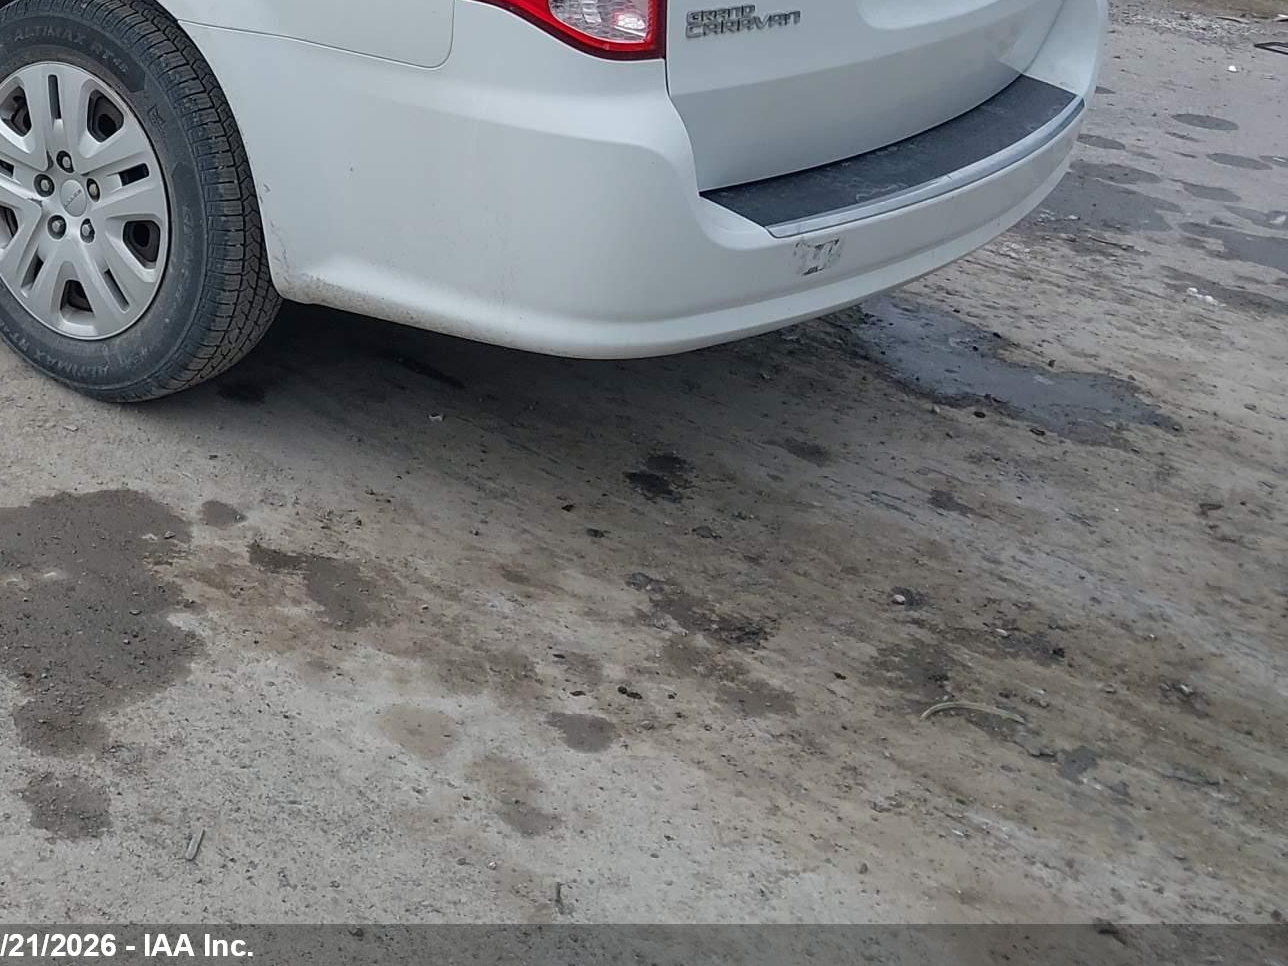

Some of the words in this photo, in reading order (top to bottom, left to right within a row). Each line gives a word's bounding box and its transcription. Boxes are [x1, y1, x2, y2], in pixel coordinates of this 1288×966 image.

[685, 10, 801, 38] CARAVAN
[686, 4, 756, 23] GRAND
[14, 25, 87, 46] ALTIMAX
